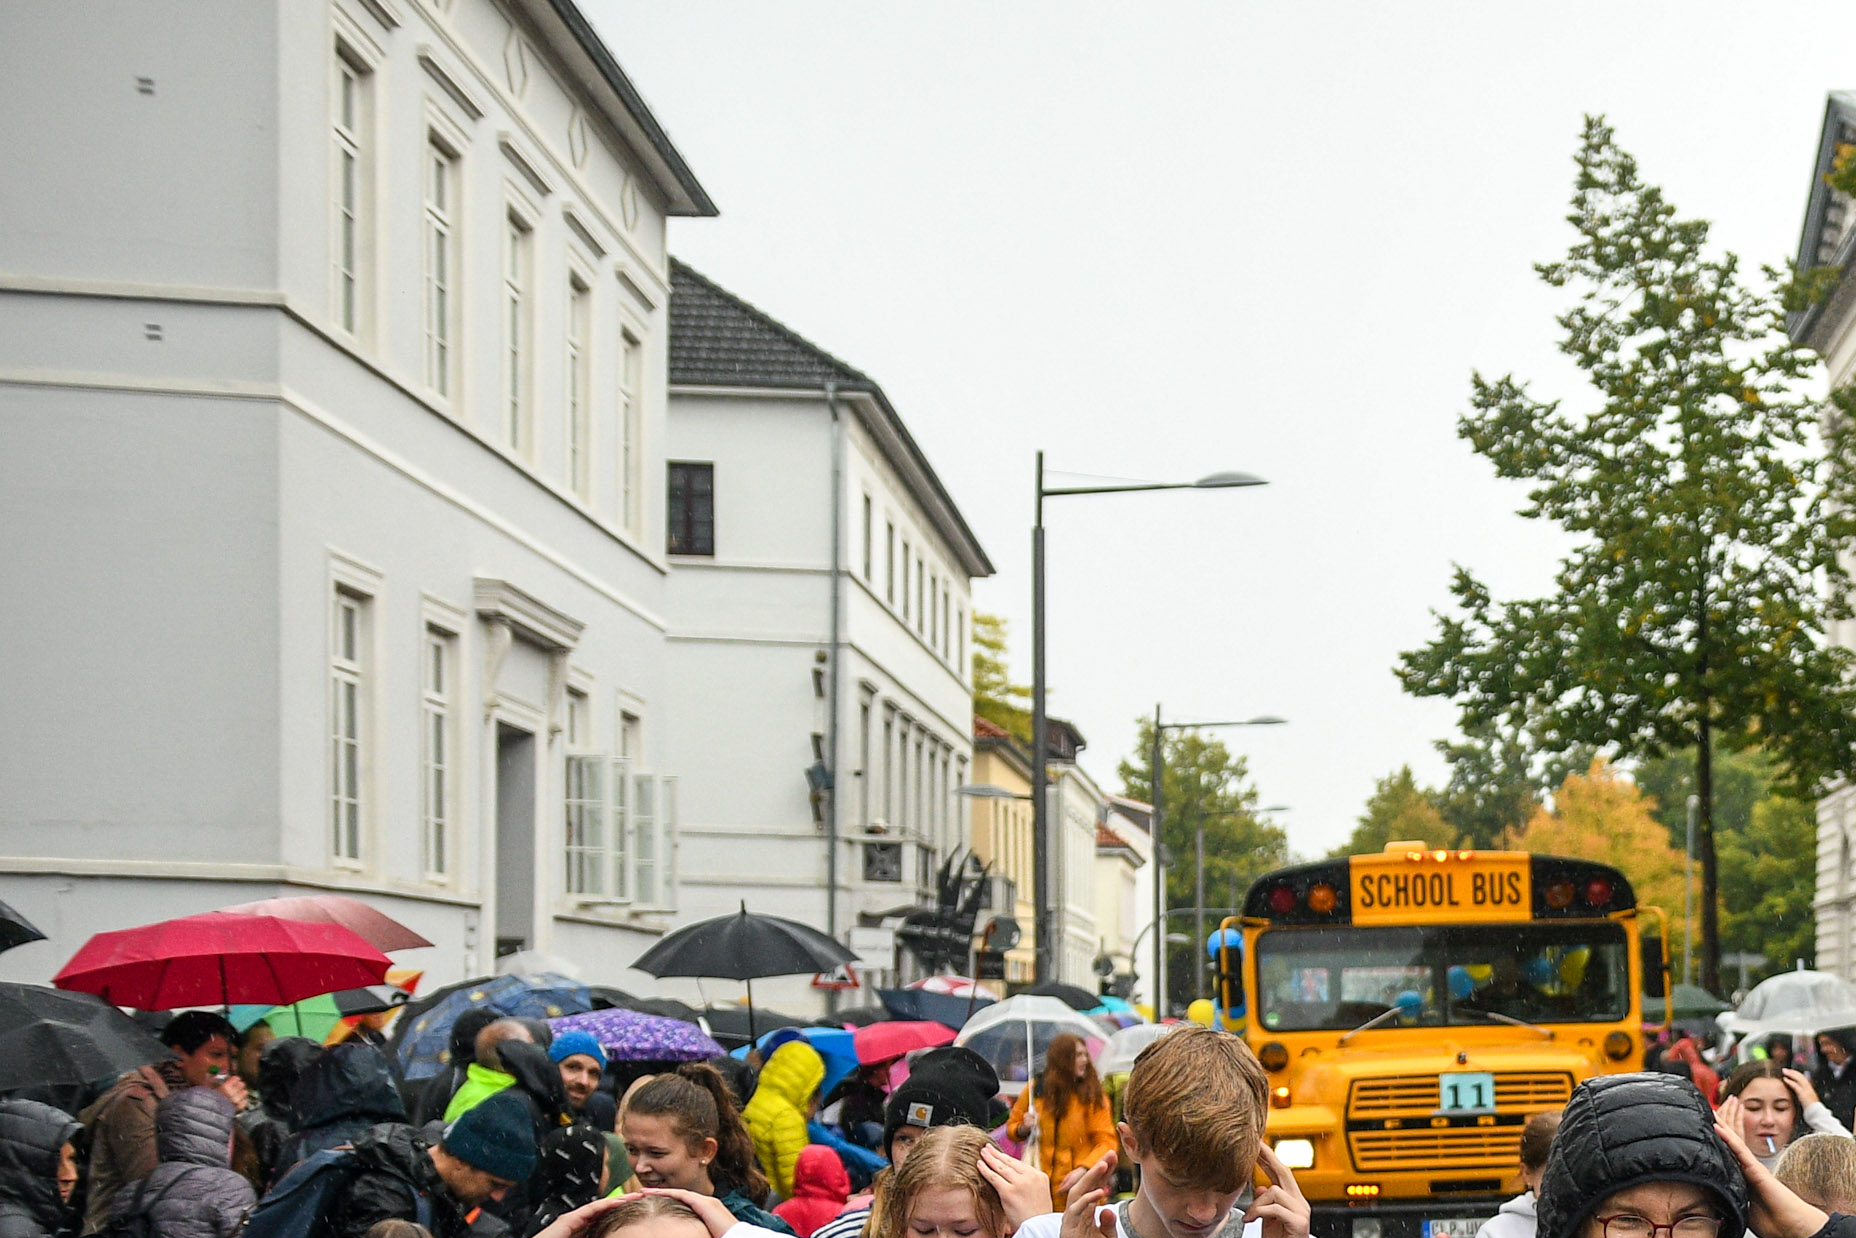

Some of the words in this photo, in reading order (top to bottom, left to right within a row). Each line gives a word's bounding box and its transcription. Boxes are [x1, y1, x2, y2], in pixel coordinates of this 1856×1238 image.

[1360, 872, 1459, 907] SCHOOL
[1472, 871, 1521, 905] BUS
[1447, 1083, 1487, 1109] 11
